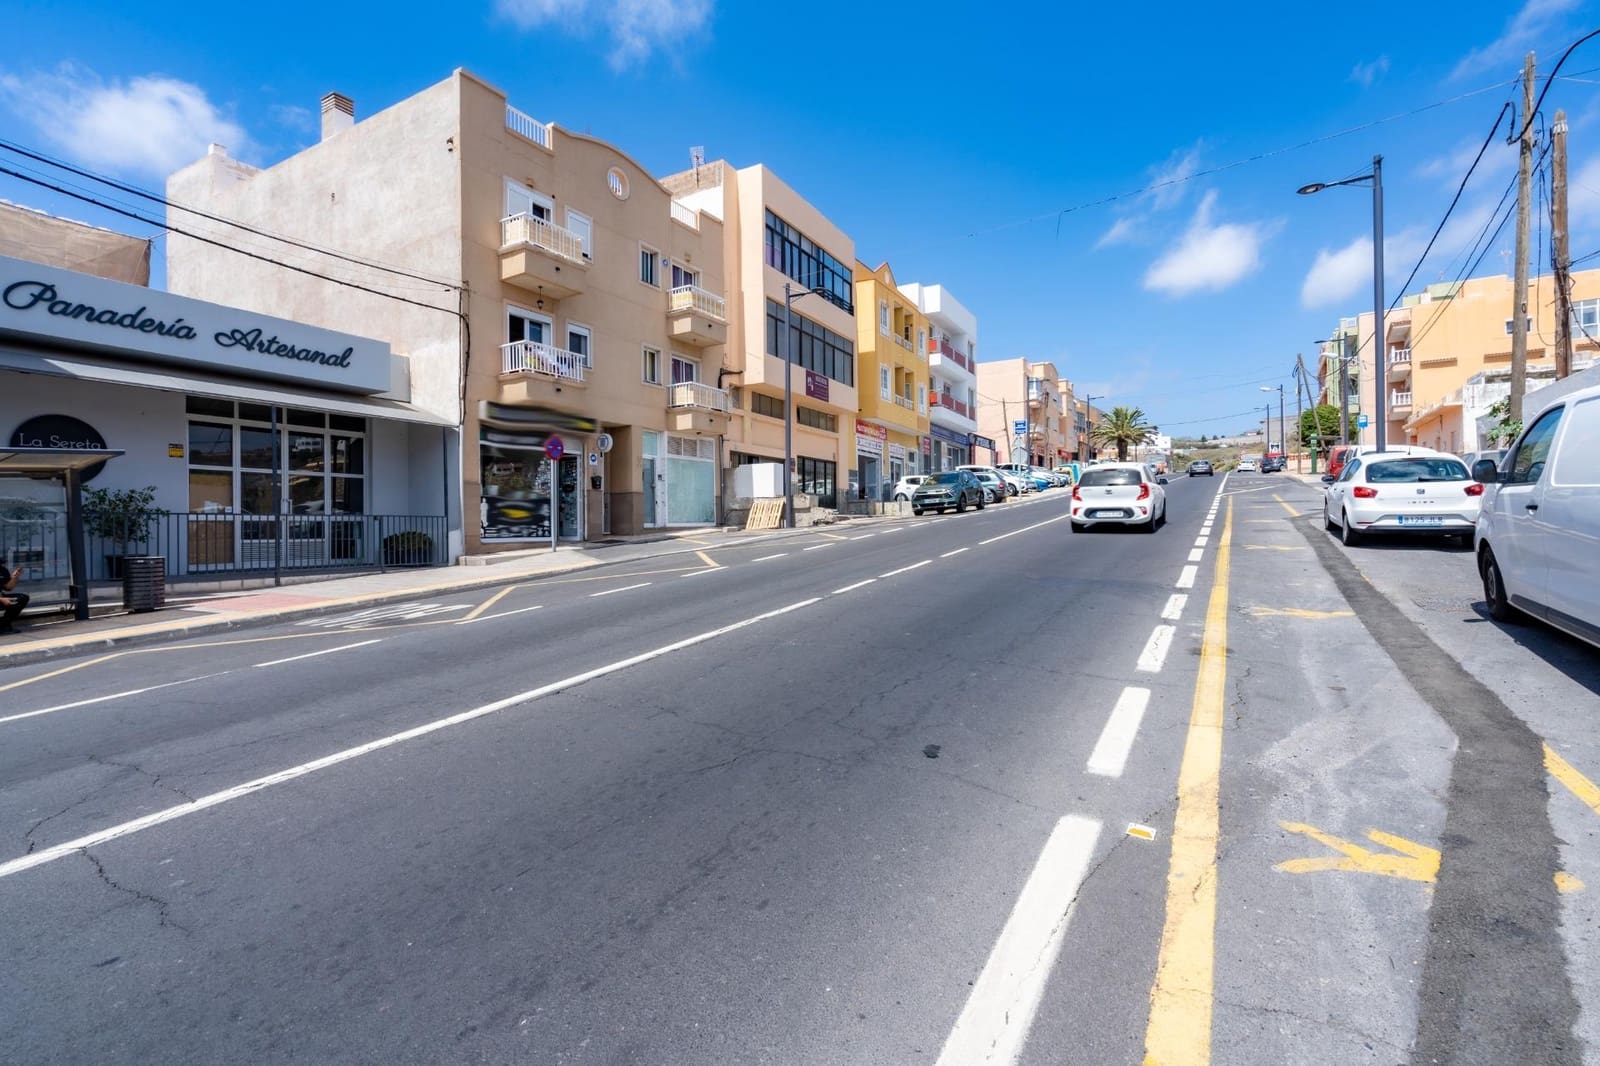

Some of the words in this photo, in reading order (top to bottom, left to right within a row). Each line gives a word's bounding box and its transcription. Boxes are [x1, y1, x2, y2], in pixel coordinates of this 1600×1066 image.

[2, 281, 197, 340] Panadería
[214, 328, 354, 368] Artesanal
[20, 432, 42, 447] La
[50, 434, 101, 449] Sereta
